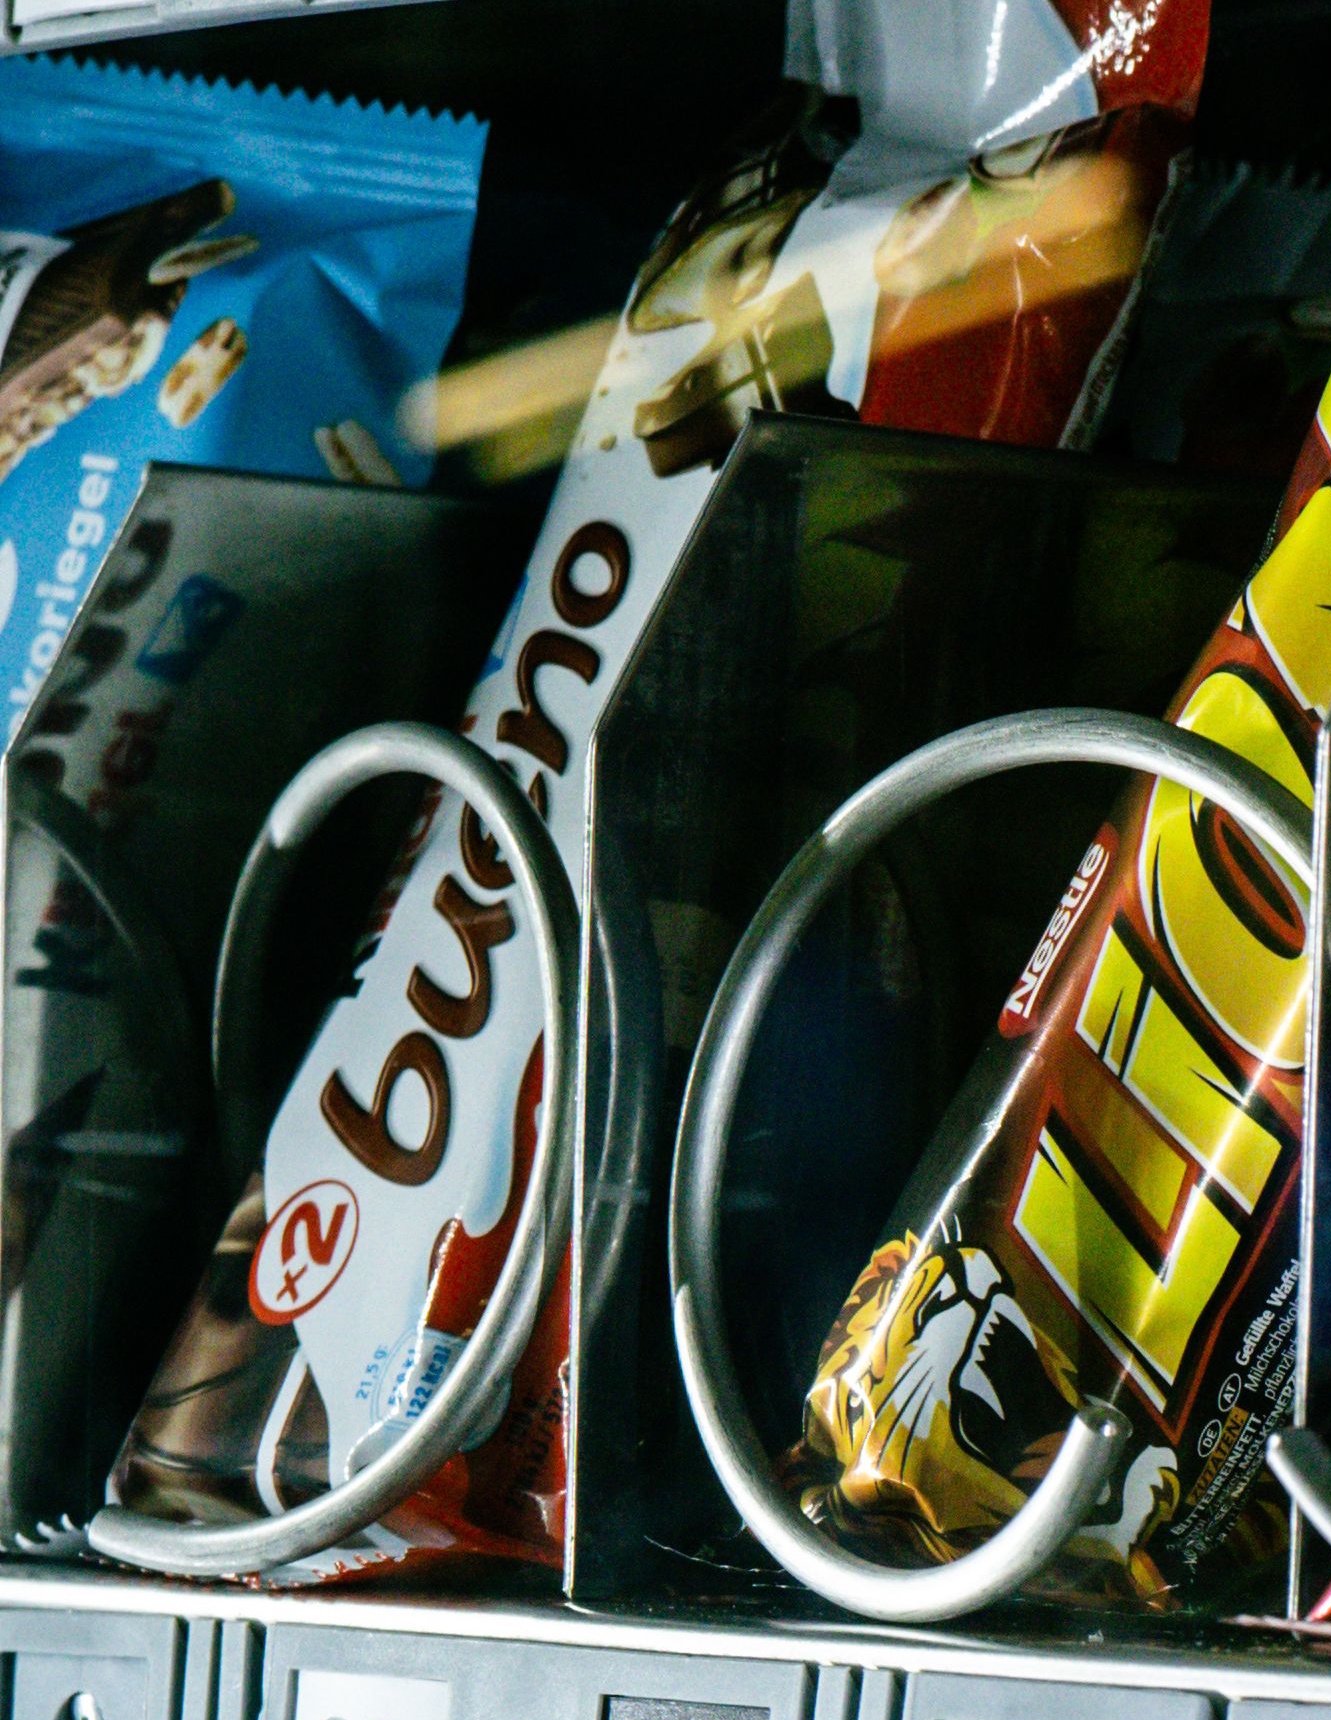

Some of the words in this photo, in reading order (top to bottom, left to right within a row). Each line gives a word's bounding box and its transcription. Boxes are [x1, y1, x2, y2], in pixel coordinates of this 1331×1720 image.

[274, 1198, 350, 1304] +2
[1235, 1308, 1276, 1367] Gefüllte
[404, 1385, 434, 1420] 122
[1222, 1383, 1237, 1404] AT
[1201, 1427, 1218, 1449] DE
